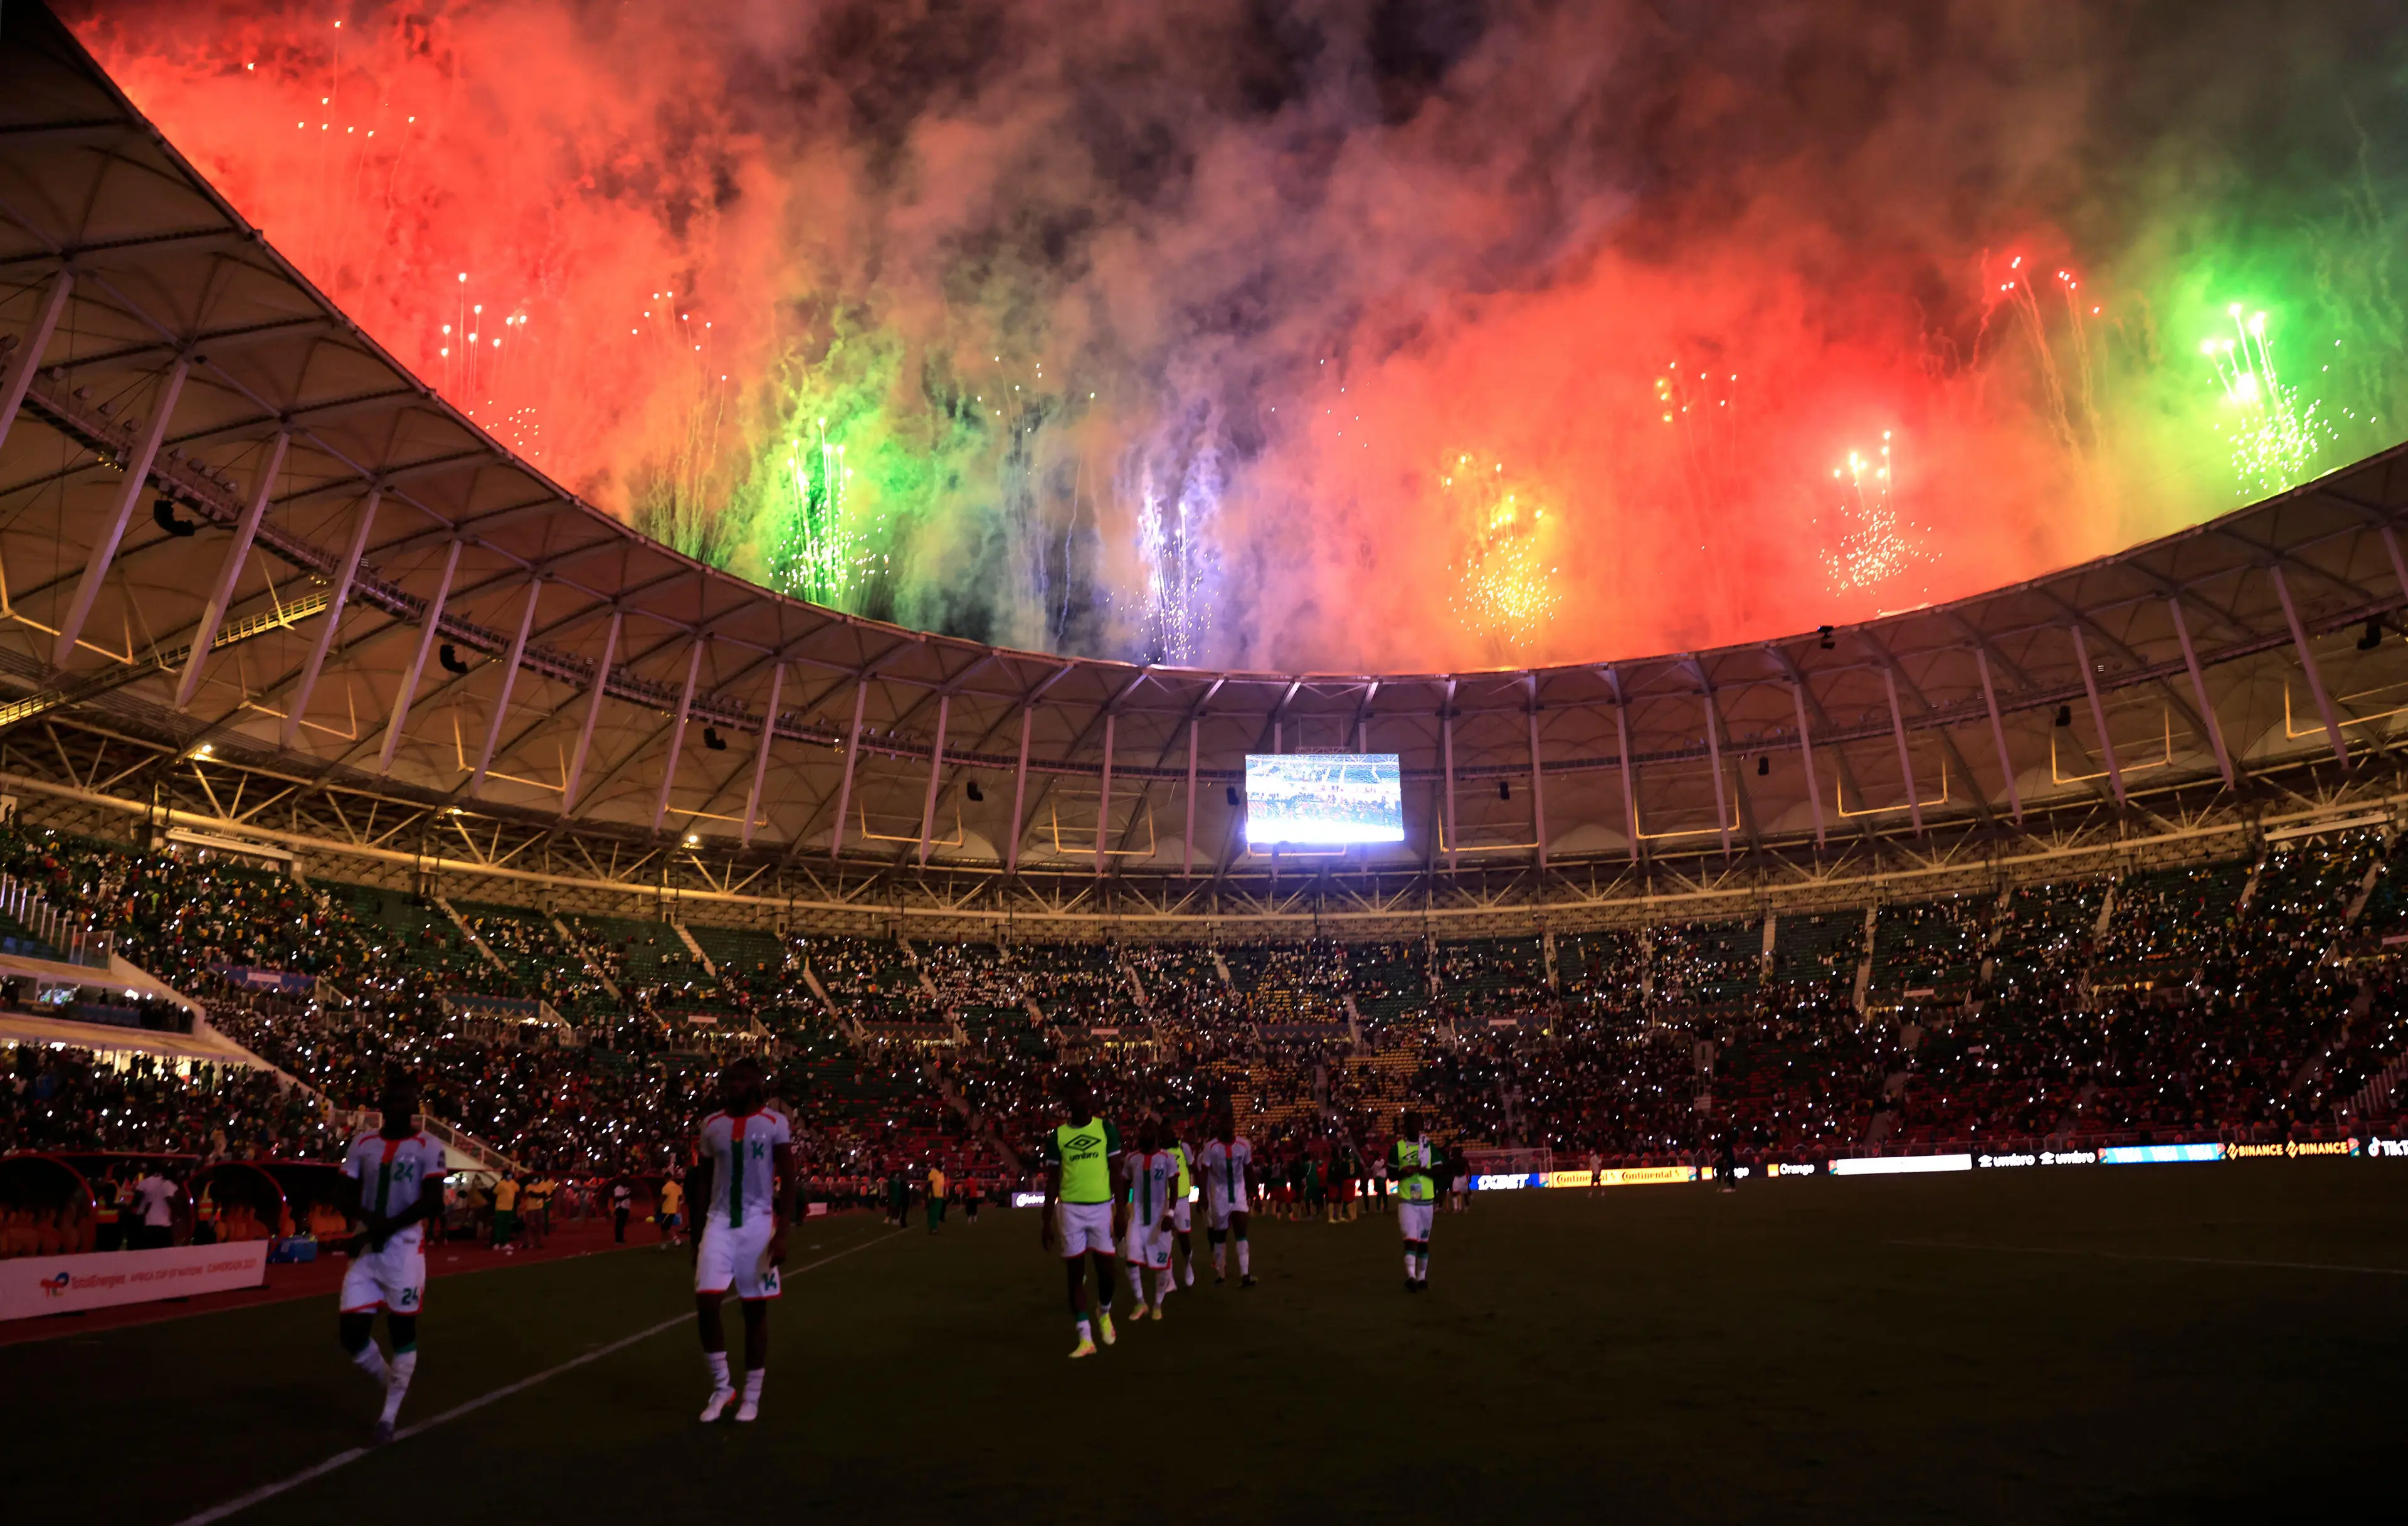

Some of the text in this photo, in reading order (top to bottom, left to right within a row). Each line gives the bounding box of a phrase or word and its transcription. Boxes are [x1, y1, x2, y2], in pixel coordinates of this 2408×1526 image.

[1069, 1152, 1099, 1161] umbro
[2238, 1142, 2348, 1157] BINANCE BINANCE
[1993, 1150, 2096, 1167] umbro umbro
[394, 1162, 413, 1181] 24
[1780, 1163, 1815, 1176] Orange
[1556, 1170, 1672, 1184] Contineal Continental
[1157, 1253, 1166, 1263] 22
[402, 1288, 418, 1305] 24
